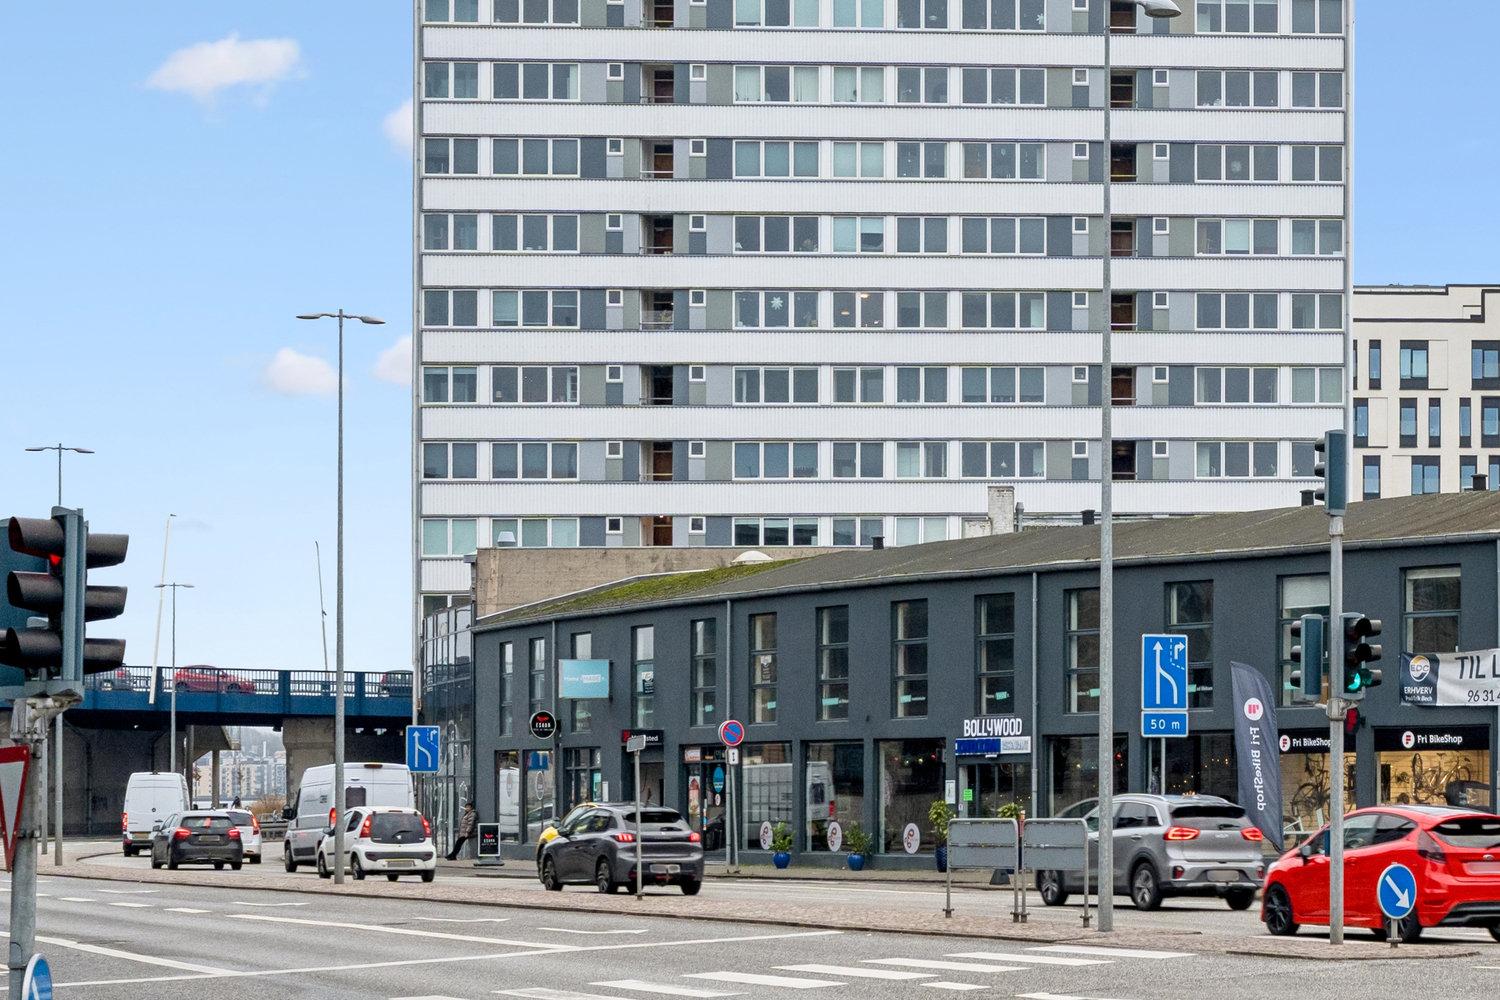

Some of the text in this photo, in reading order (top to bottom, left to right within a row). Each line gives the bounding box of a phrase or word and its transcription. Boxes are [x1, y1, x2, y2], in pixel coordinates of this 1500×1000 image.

[1410, 664, 1429, 672] EDC
[1455, 655, 1486, 679] TIL
[1404, 686, 1432, 694] ERHVERV
[1468, 691, 1479, 702] 96
[1483, 690, 1494, 701] 31
[964, 718, 1022, 737] BOLLYWOOD
[1151, 720, 1166, 730] 50
[1293, 738, 1302, 746] Fri
[1418, 735, 1427, 743] Fri
[1430, 734, 1463, 745] BikeShop
